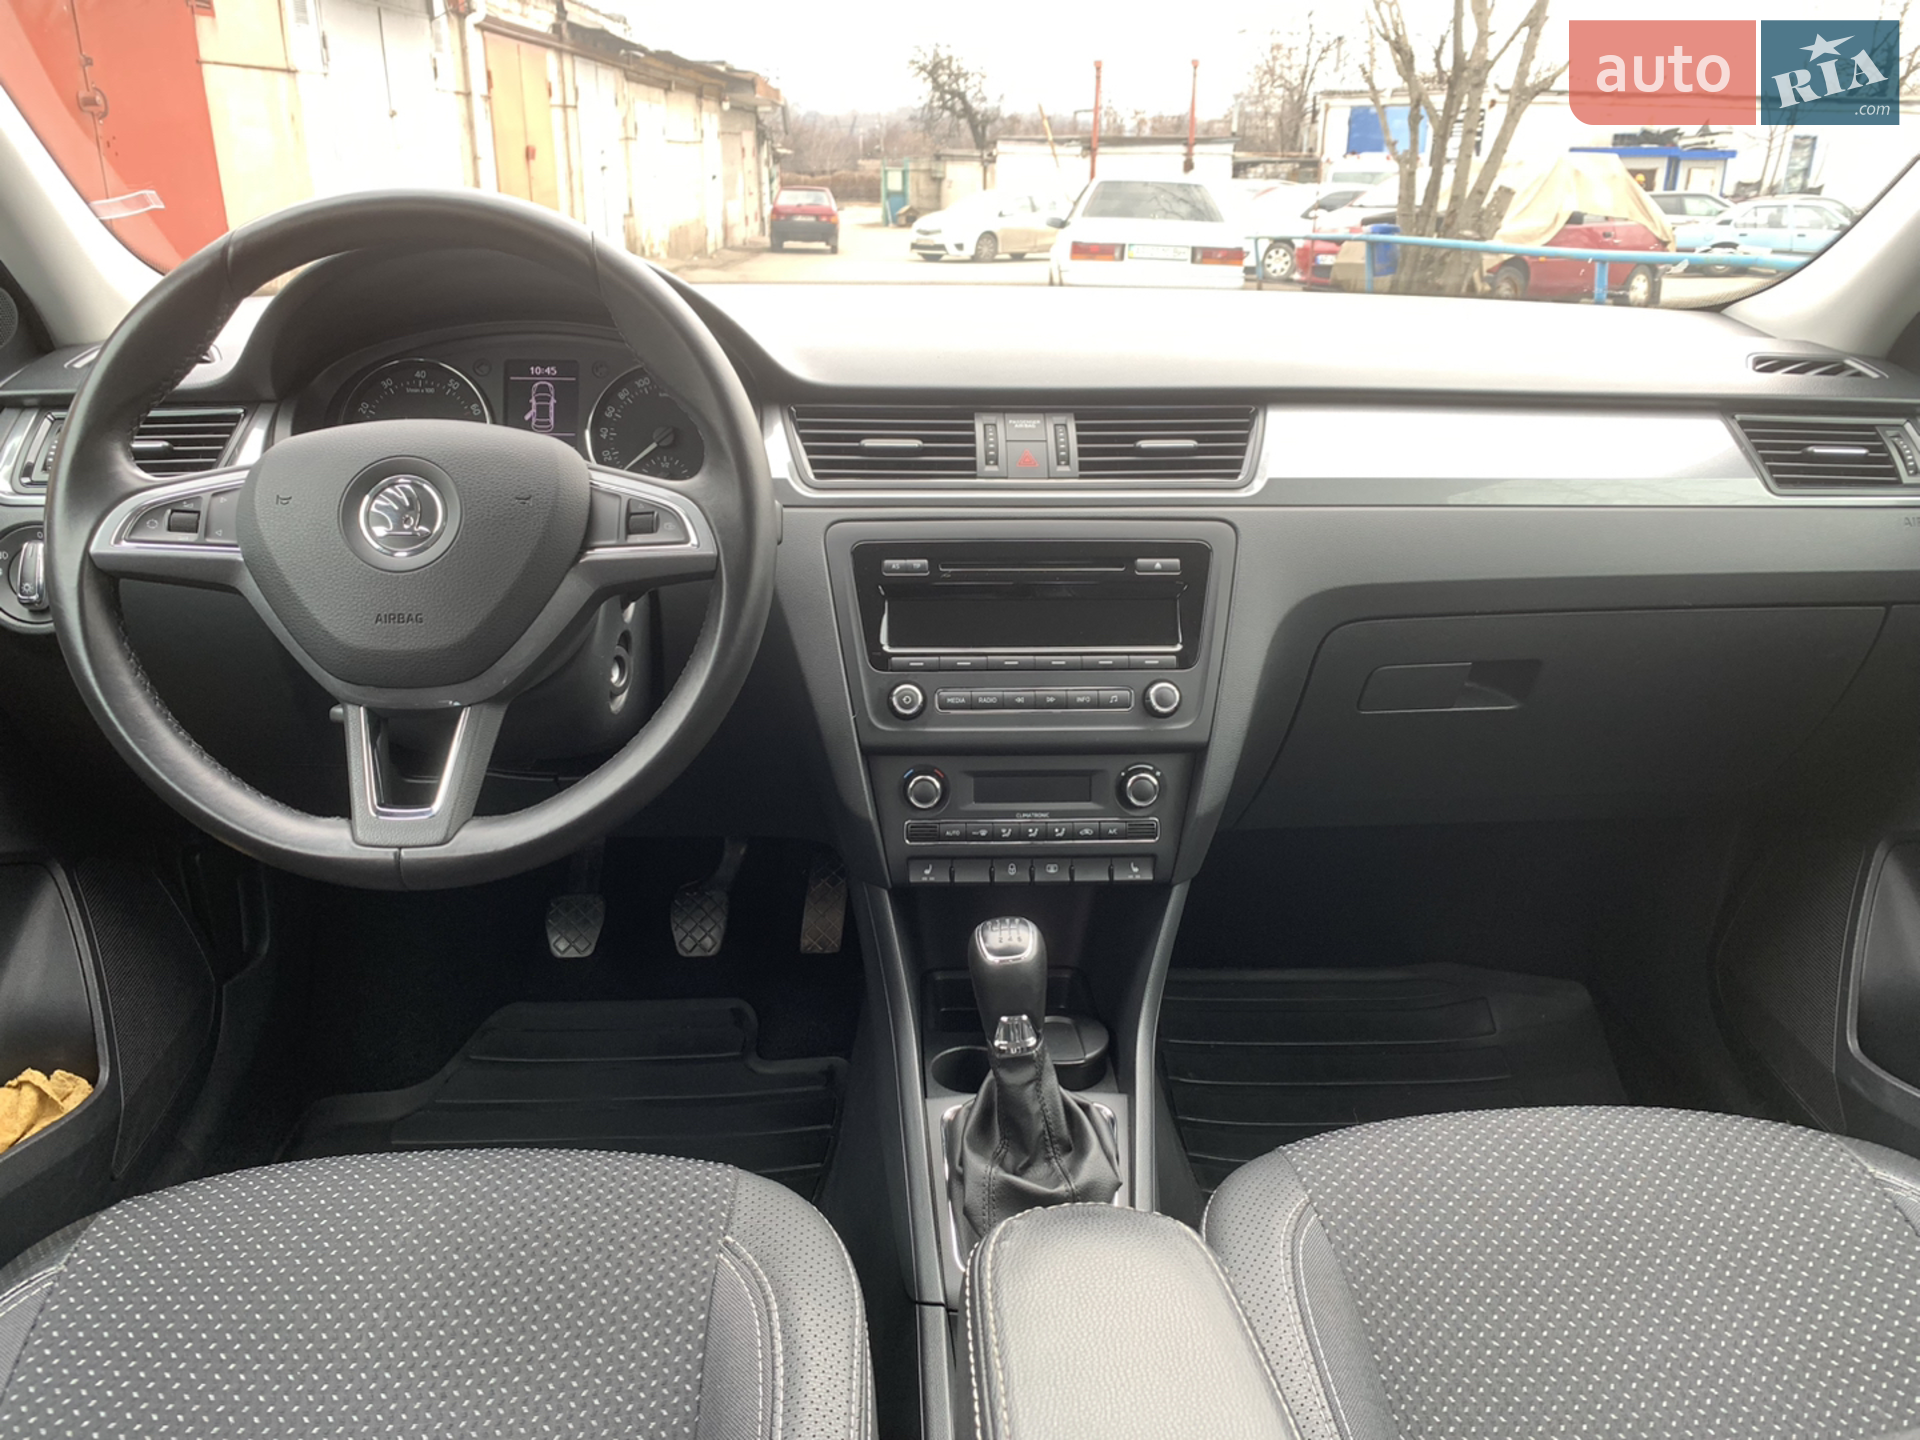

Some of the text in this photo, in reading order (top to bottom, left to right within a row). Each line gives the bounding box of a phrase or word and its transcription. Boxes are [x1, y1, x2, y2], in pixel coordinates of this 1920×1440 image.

[414, 370, 426, 379] 40
[529, 366, 557, 376] 10:45
[380, 377, 393, 389] 30
[448, 379, 460, 390] 50
[634, 377, 651, 388] 100
[617, 388, 630, 400] 80
[358, 401, 370, 415] 20
[470, 403, 481, 416] 60
[604, 405, 616, 418] 60
[600, 427, 609, 439] 40
[602, 450, 612, 462] 20
[375, 612, 424, 625] AIRBAG
